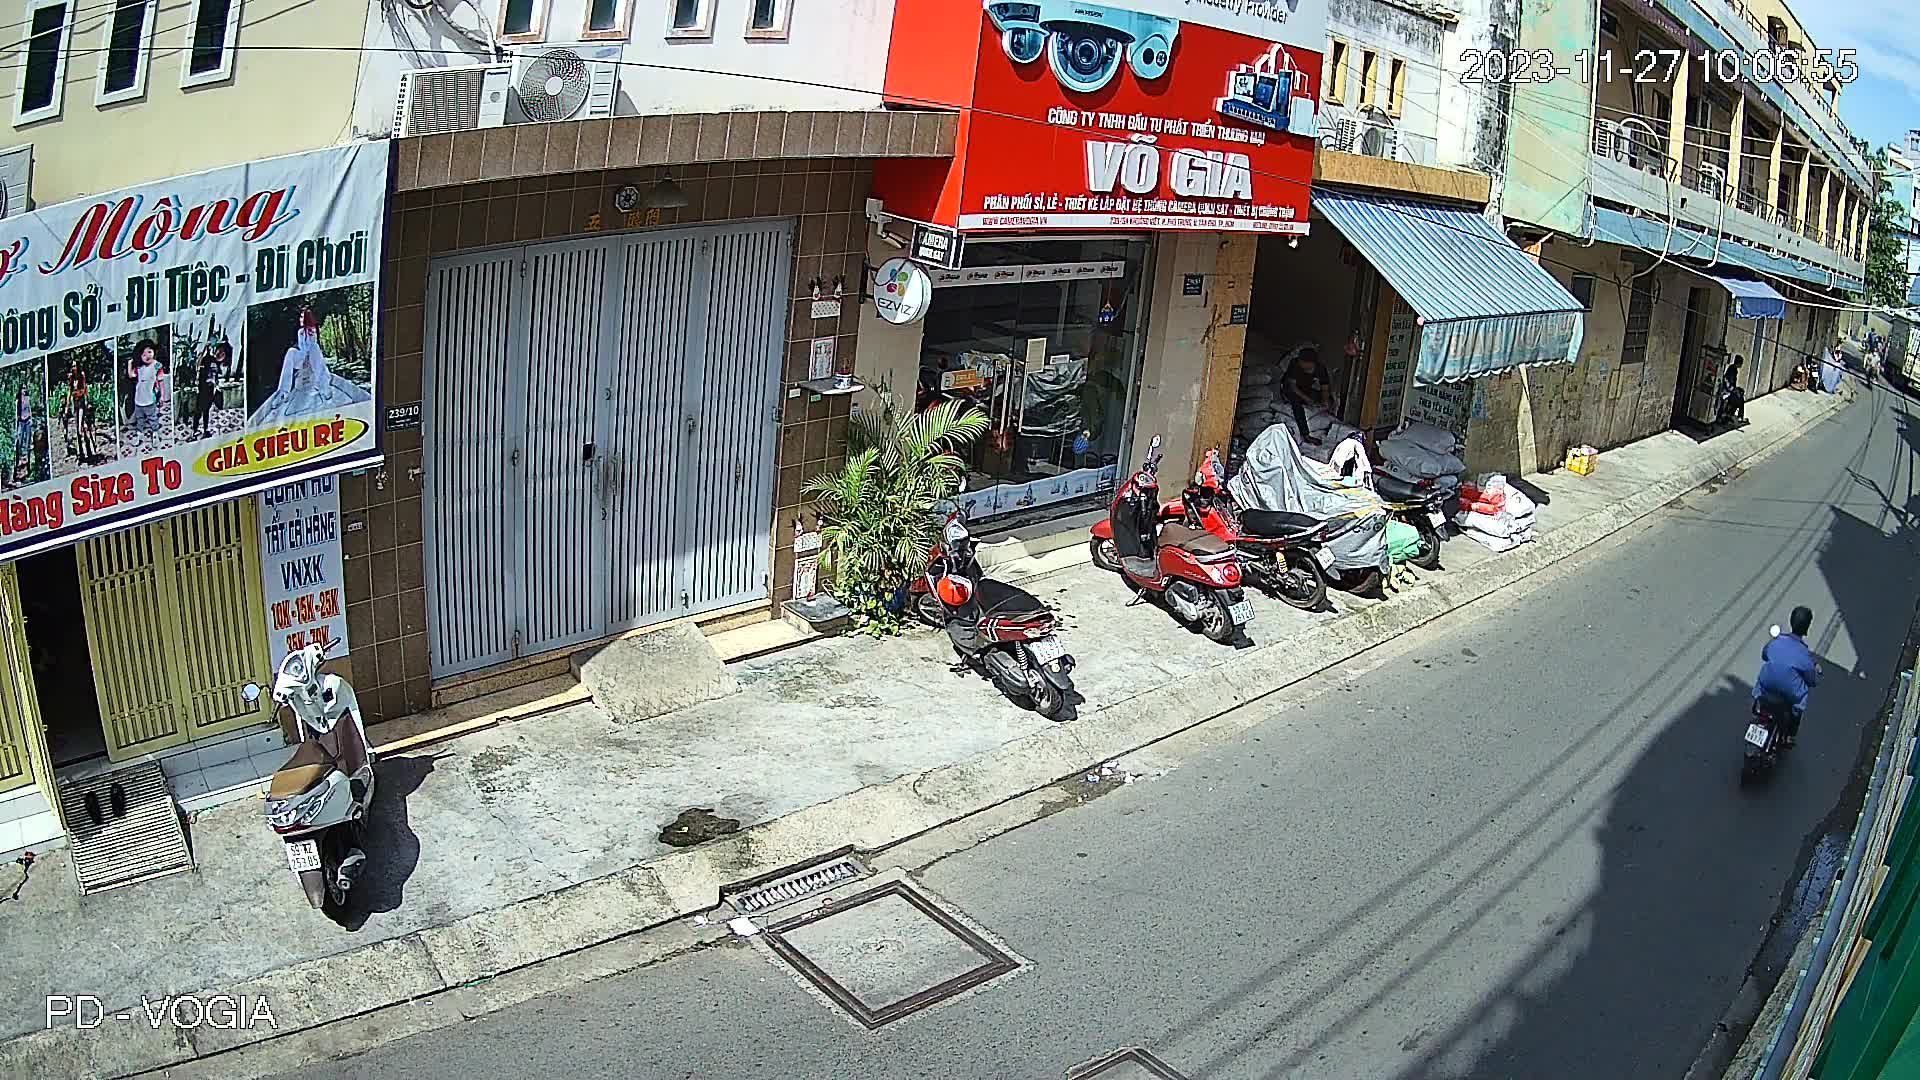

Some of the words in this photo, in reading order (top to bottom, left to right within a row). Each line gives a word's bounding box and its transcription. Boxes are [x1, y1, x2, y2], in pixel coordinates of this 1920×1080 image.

[1047, 106, 1077, 127] CÔNG
[1081, 111, 1095, 127] TY
[1098, 112, 1126, 130] TNHH
[1163, 117, 1189, 136] PHÁT
[1086, 133, 1160, 194] VÕ
[1170, 148, 1253, 200] GIA
[983, 193, 1009, 210] PHÂN
[1010, 192, 1032, 210] PHỐI
[1064, 193, 1087, 210] THIẾT
[38, 185, 300, 275] Mộng
[0, 308, 57, 354] ông
[63, 283, 103, 338] Sở
[126, 272, 160, 322] Đi
[164, 260, 230, 315] Tiệc
[256, 245, 290, 293] Đi
[296, 231, 368, 285] Chơi
[878, 297, 912, 316] EZVIZ
[388, 406, 419, 419] 239/10
[206, 438, 249, 473] GIÁ
[253, 427, 308, 462] SIÊU
[314, 414, 345, 448] RẺ
[71, 471, 135, 516] Size
[141, 456, 182, 496] To
[264, 509, 287, 554] TẤT
[288, 508, 303, 550] CẢ
[304, 505, 338, 546] HÀNG
[281, 553, 326, 591] VNXK
[271, 599, 292, 630] 10K
[295, 593, 317, 624] 15K
[320, 588, 341, 619] 25K
